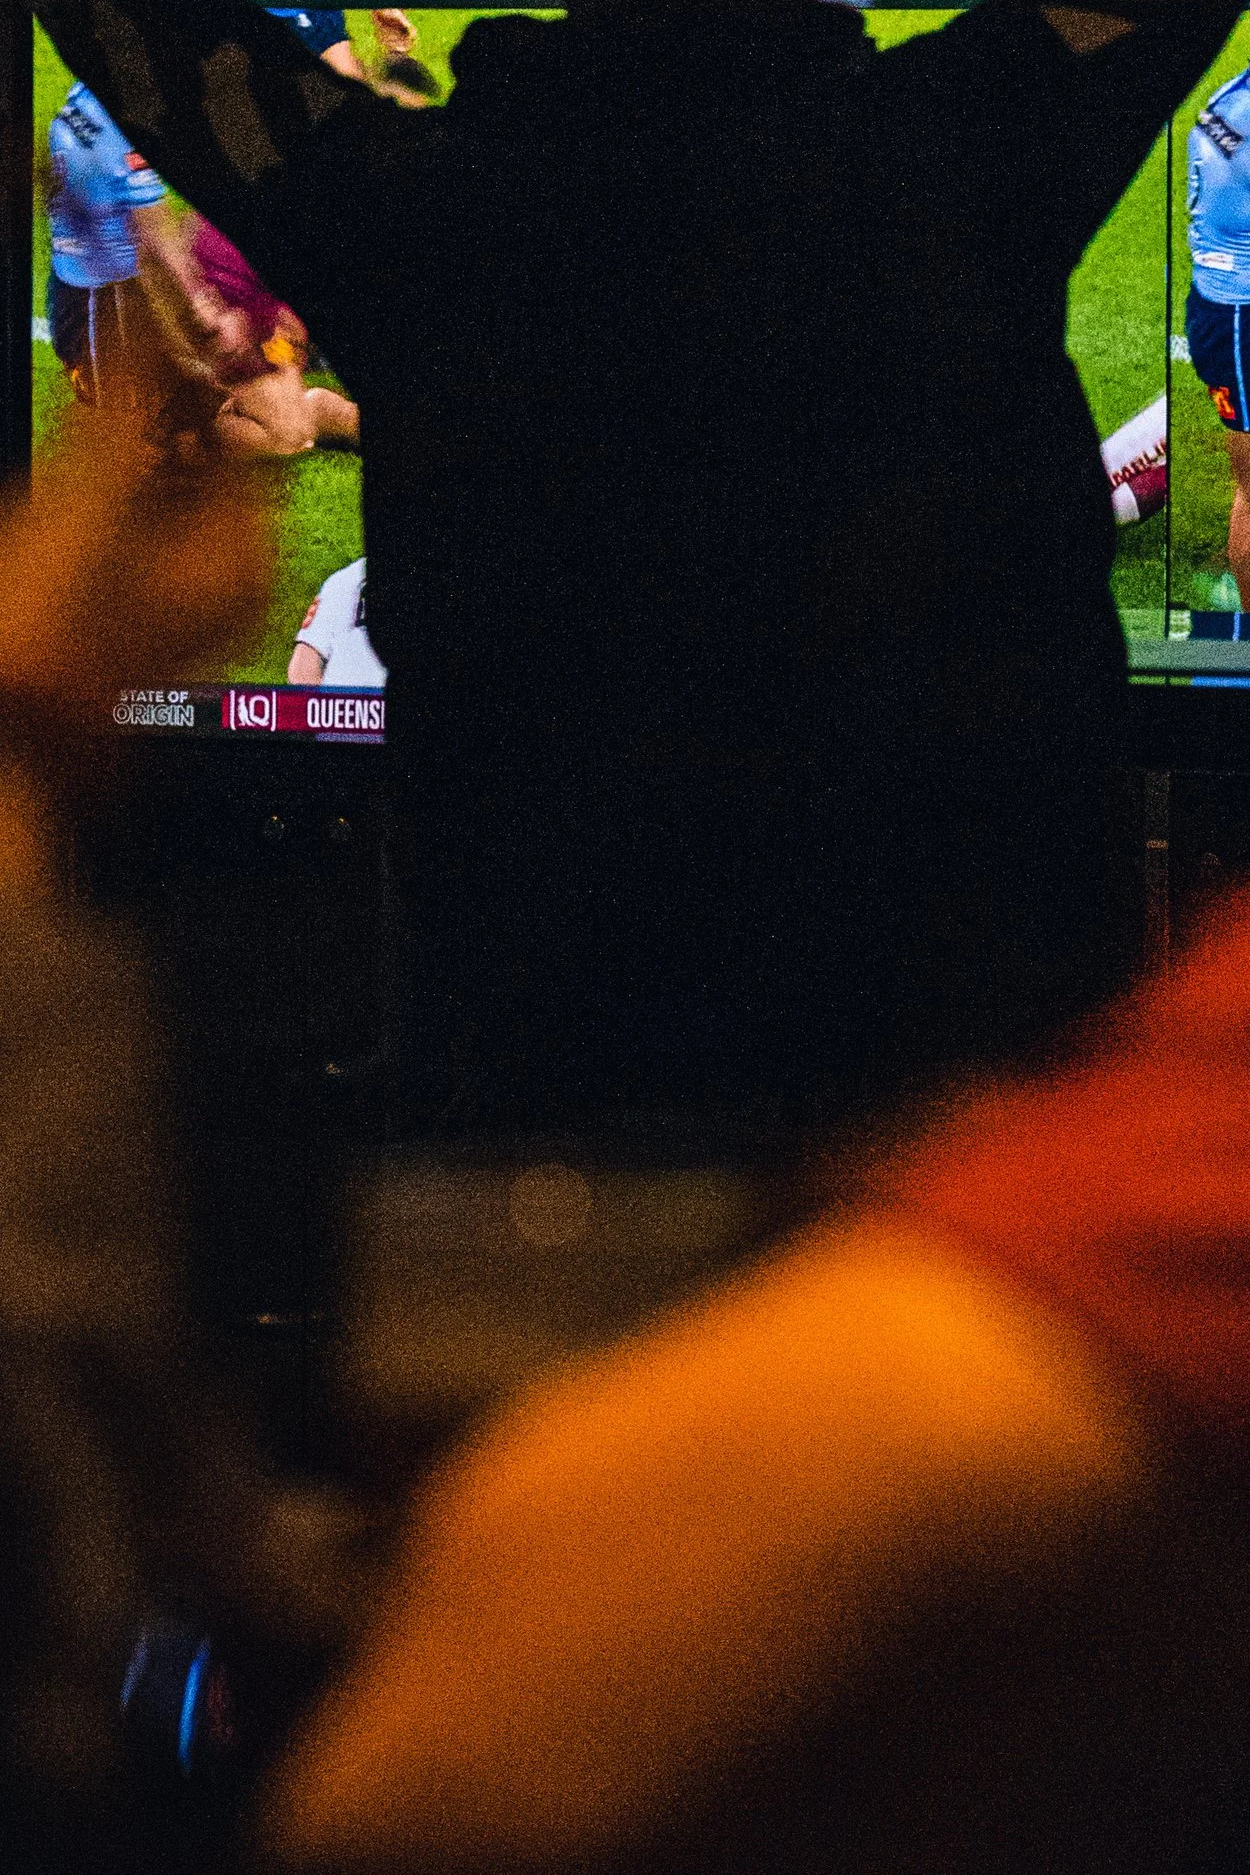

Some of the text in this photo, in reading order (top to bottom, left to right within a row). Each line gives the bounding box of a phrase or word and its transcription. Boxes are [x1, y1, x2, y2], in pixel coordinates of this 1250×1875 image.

[119, 689, 189, 703] STATE OF
[113, 703, 194, 726] ORIGIN
